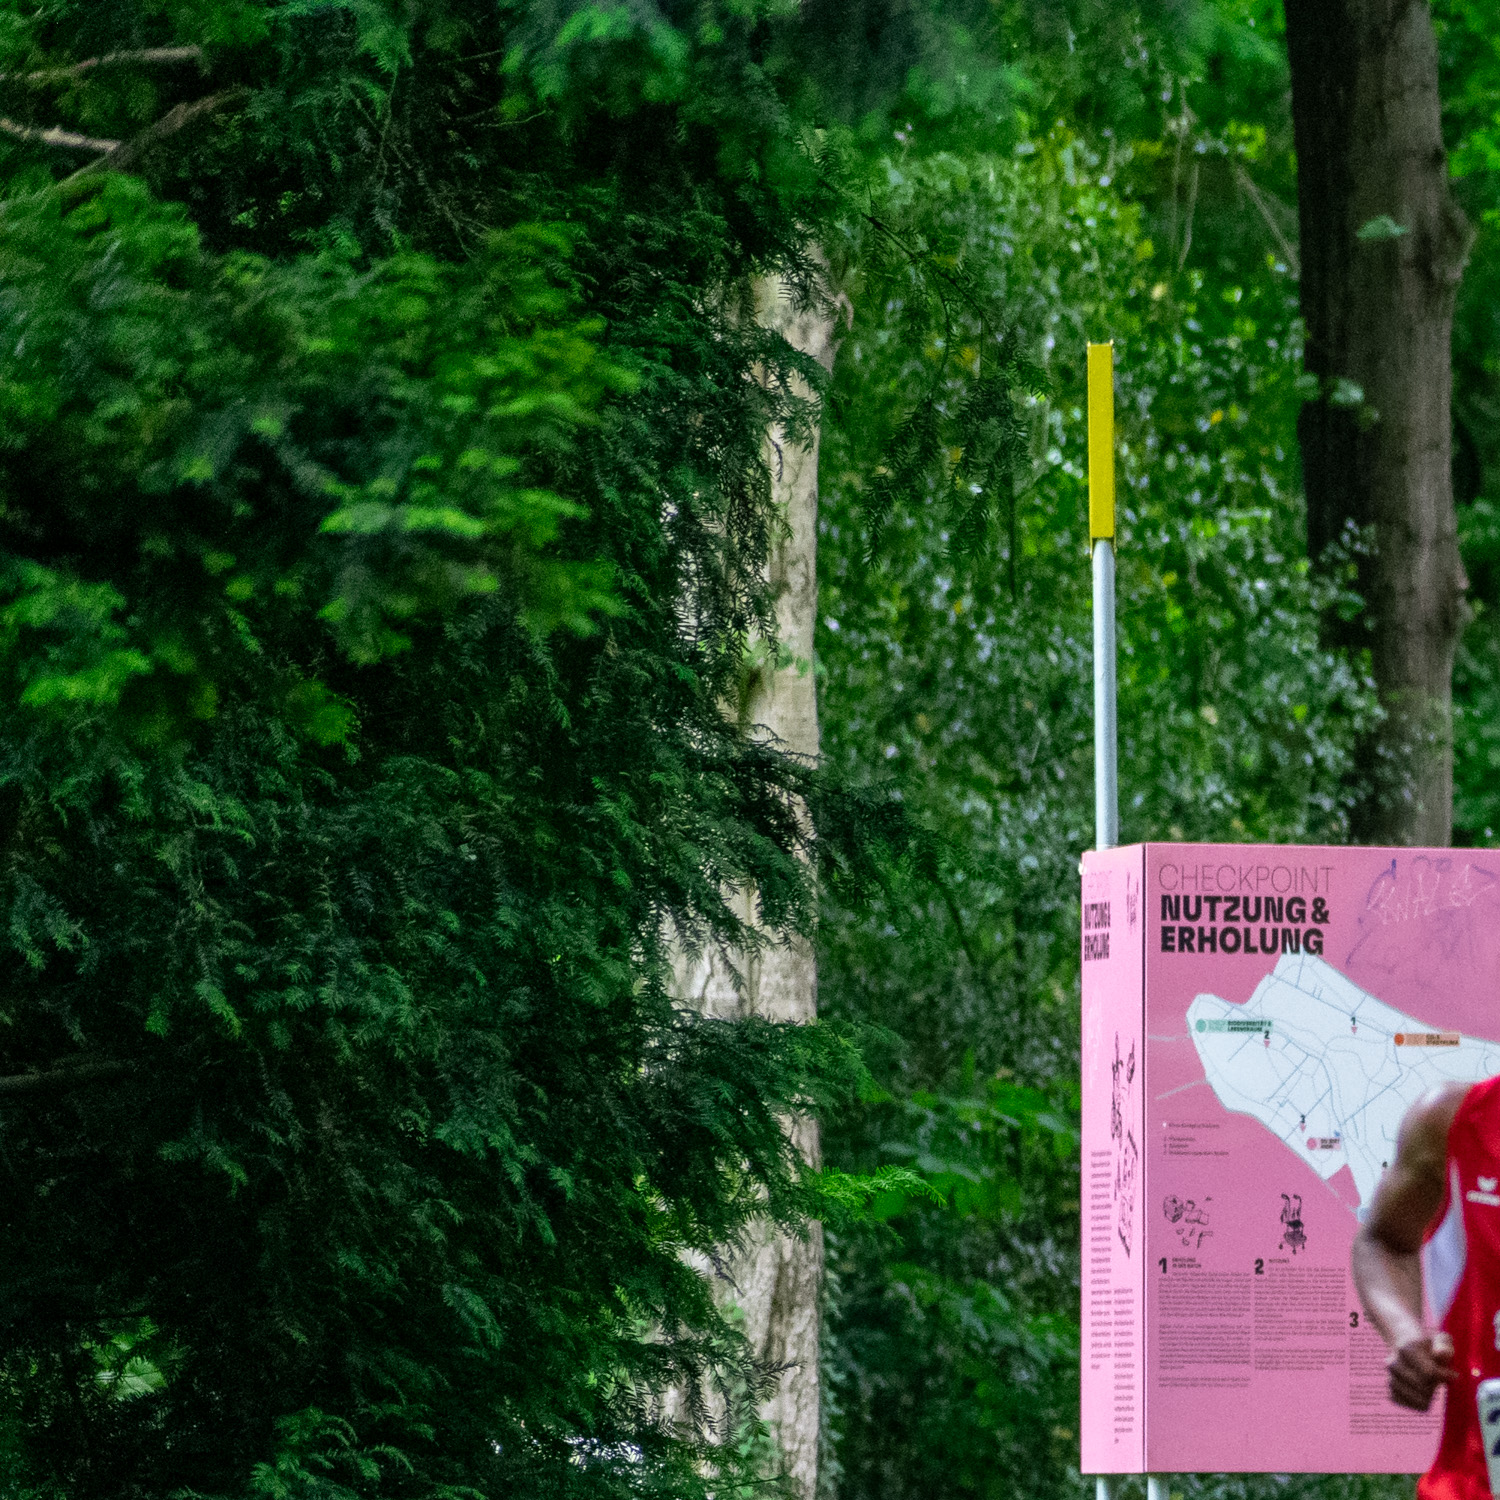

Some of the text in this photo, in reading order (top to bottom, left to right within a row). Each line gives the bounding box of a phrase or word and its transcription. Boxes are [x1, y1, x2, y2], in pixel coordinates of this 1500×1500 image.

[1158, 863, 1335, 893] CHECKPOINT
[1160, 894, 1331, 924] NUTZUNG &
[1160, 926, 1325, 955] ERHOLUNG
[1264, 1030, 1270, 1040] 2
[1158, 1257, 1167, 1274] 1
[1254, 1258, 1264, 1275] 2
[1349, 1312, 1359, 1328] 3
